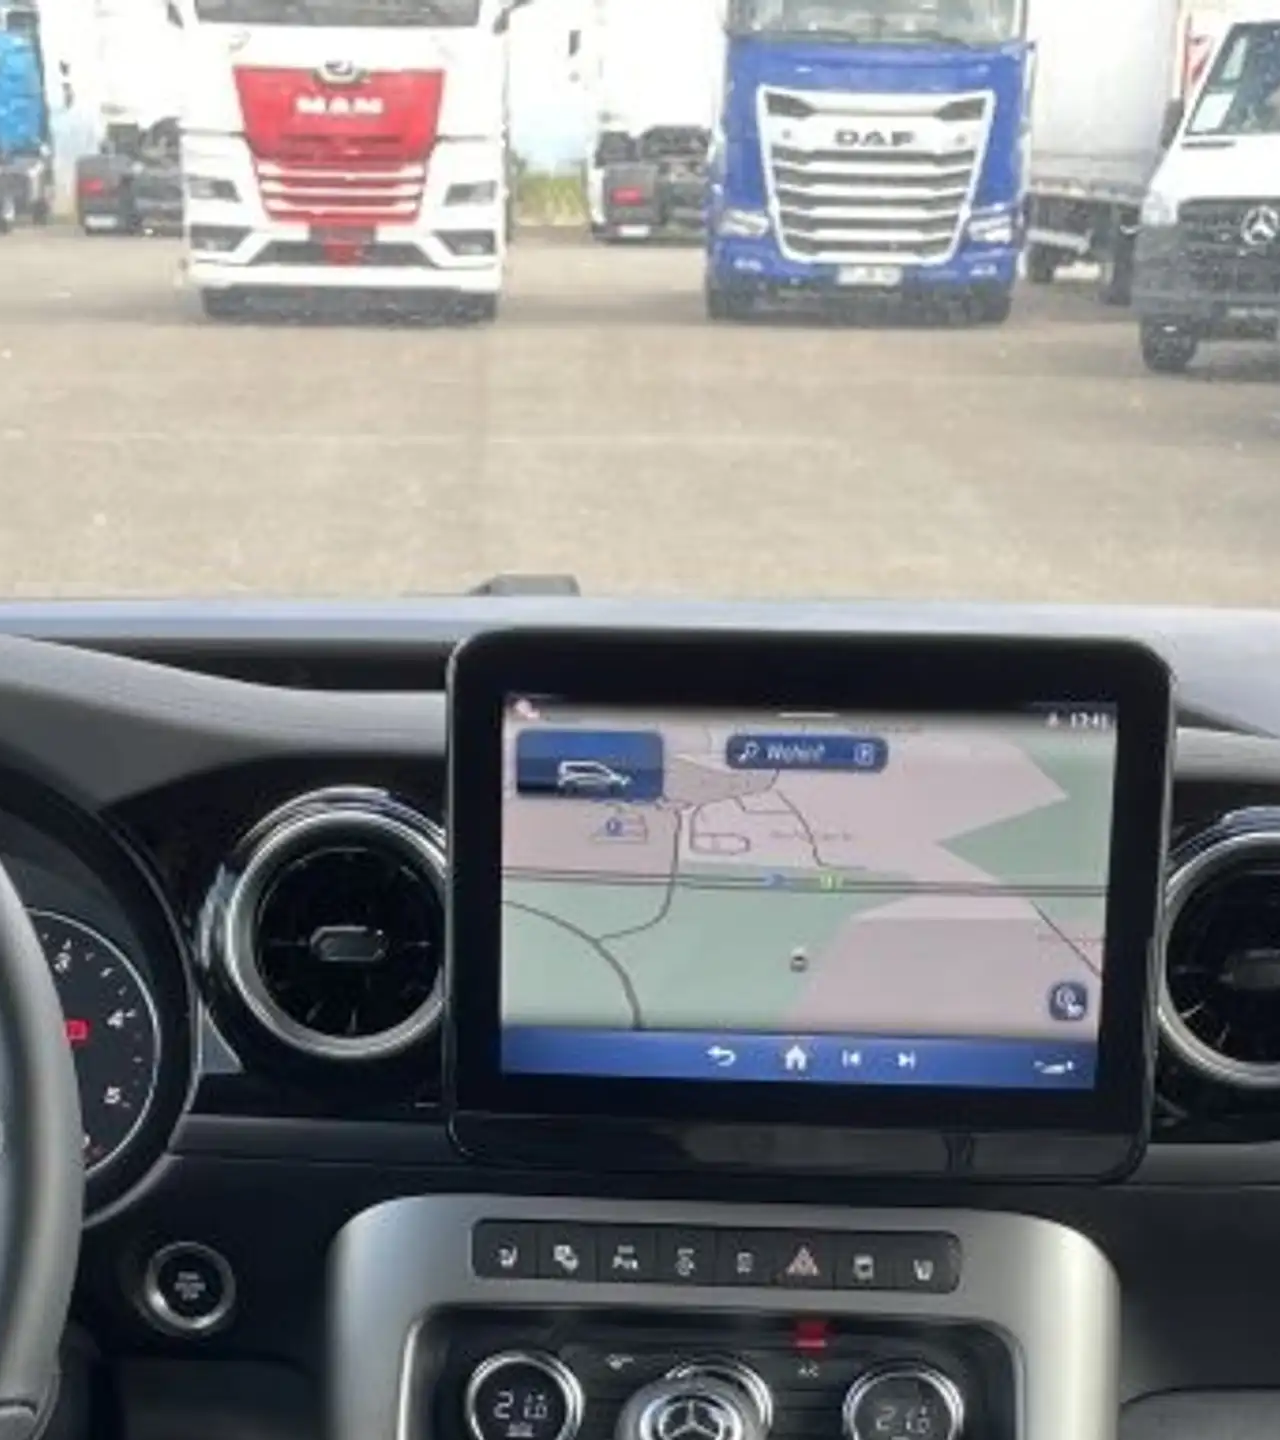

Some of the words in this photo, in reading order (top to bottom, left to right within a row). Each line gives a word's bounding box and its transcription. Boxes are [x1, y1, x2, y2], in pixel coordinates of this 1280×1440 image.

[295, 96, 383, 115] MAN
[834, 129, 914, 147] DAF
[54, 952, 70, 972] 3
[107, 1010, 123, 1028] 4
[104, 1087, 121, 1104] 5
